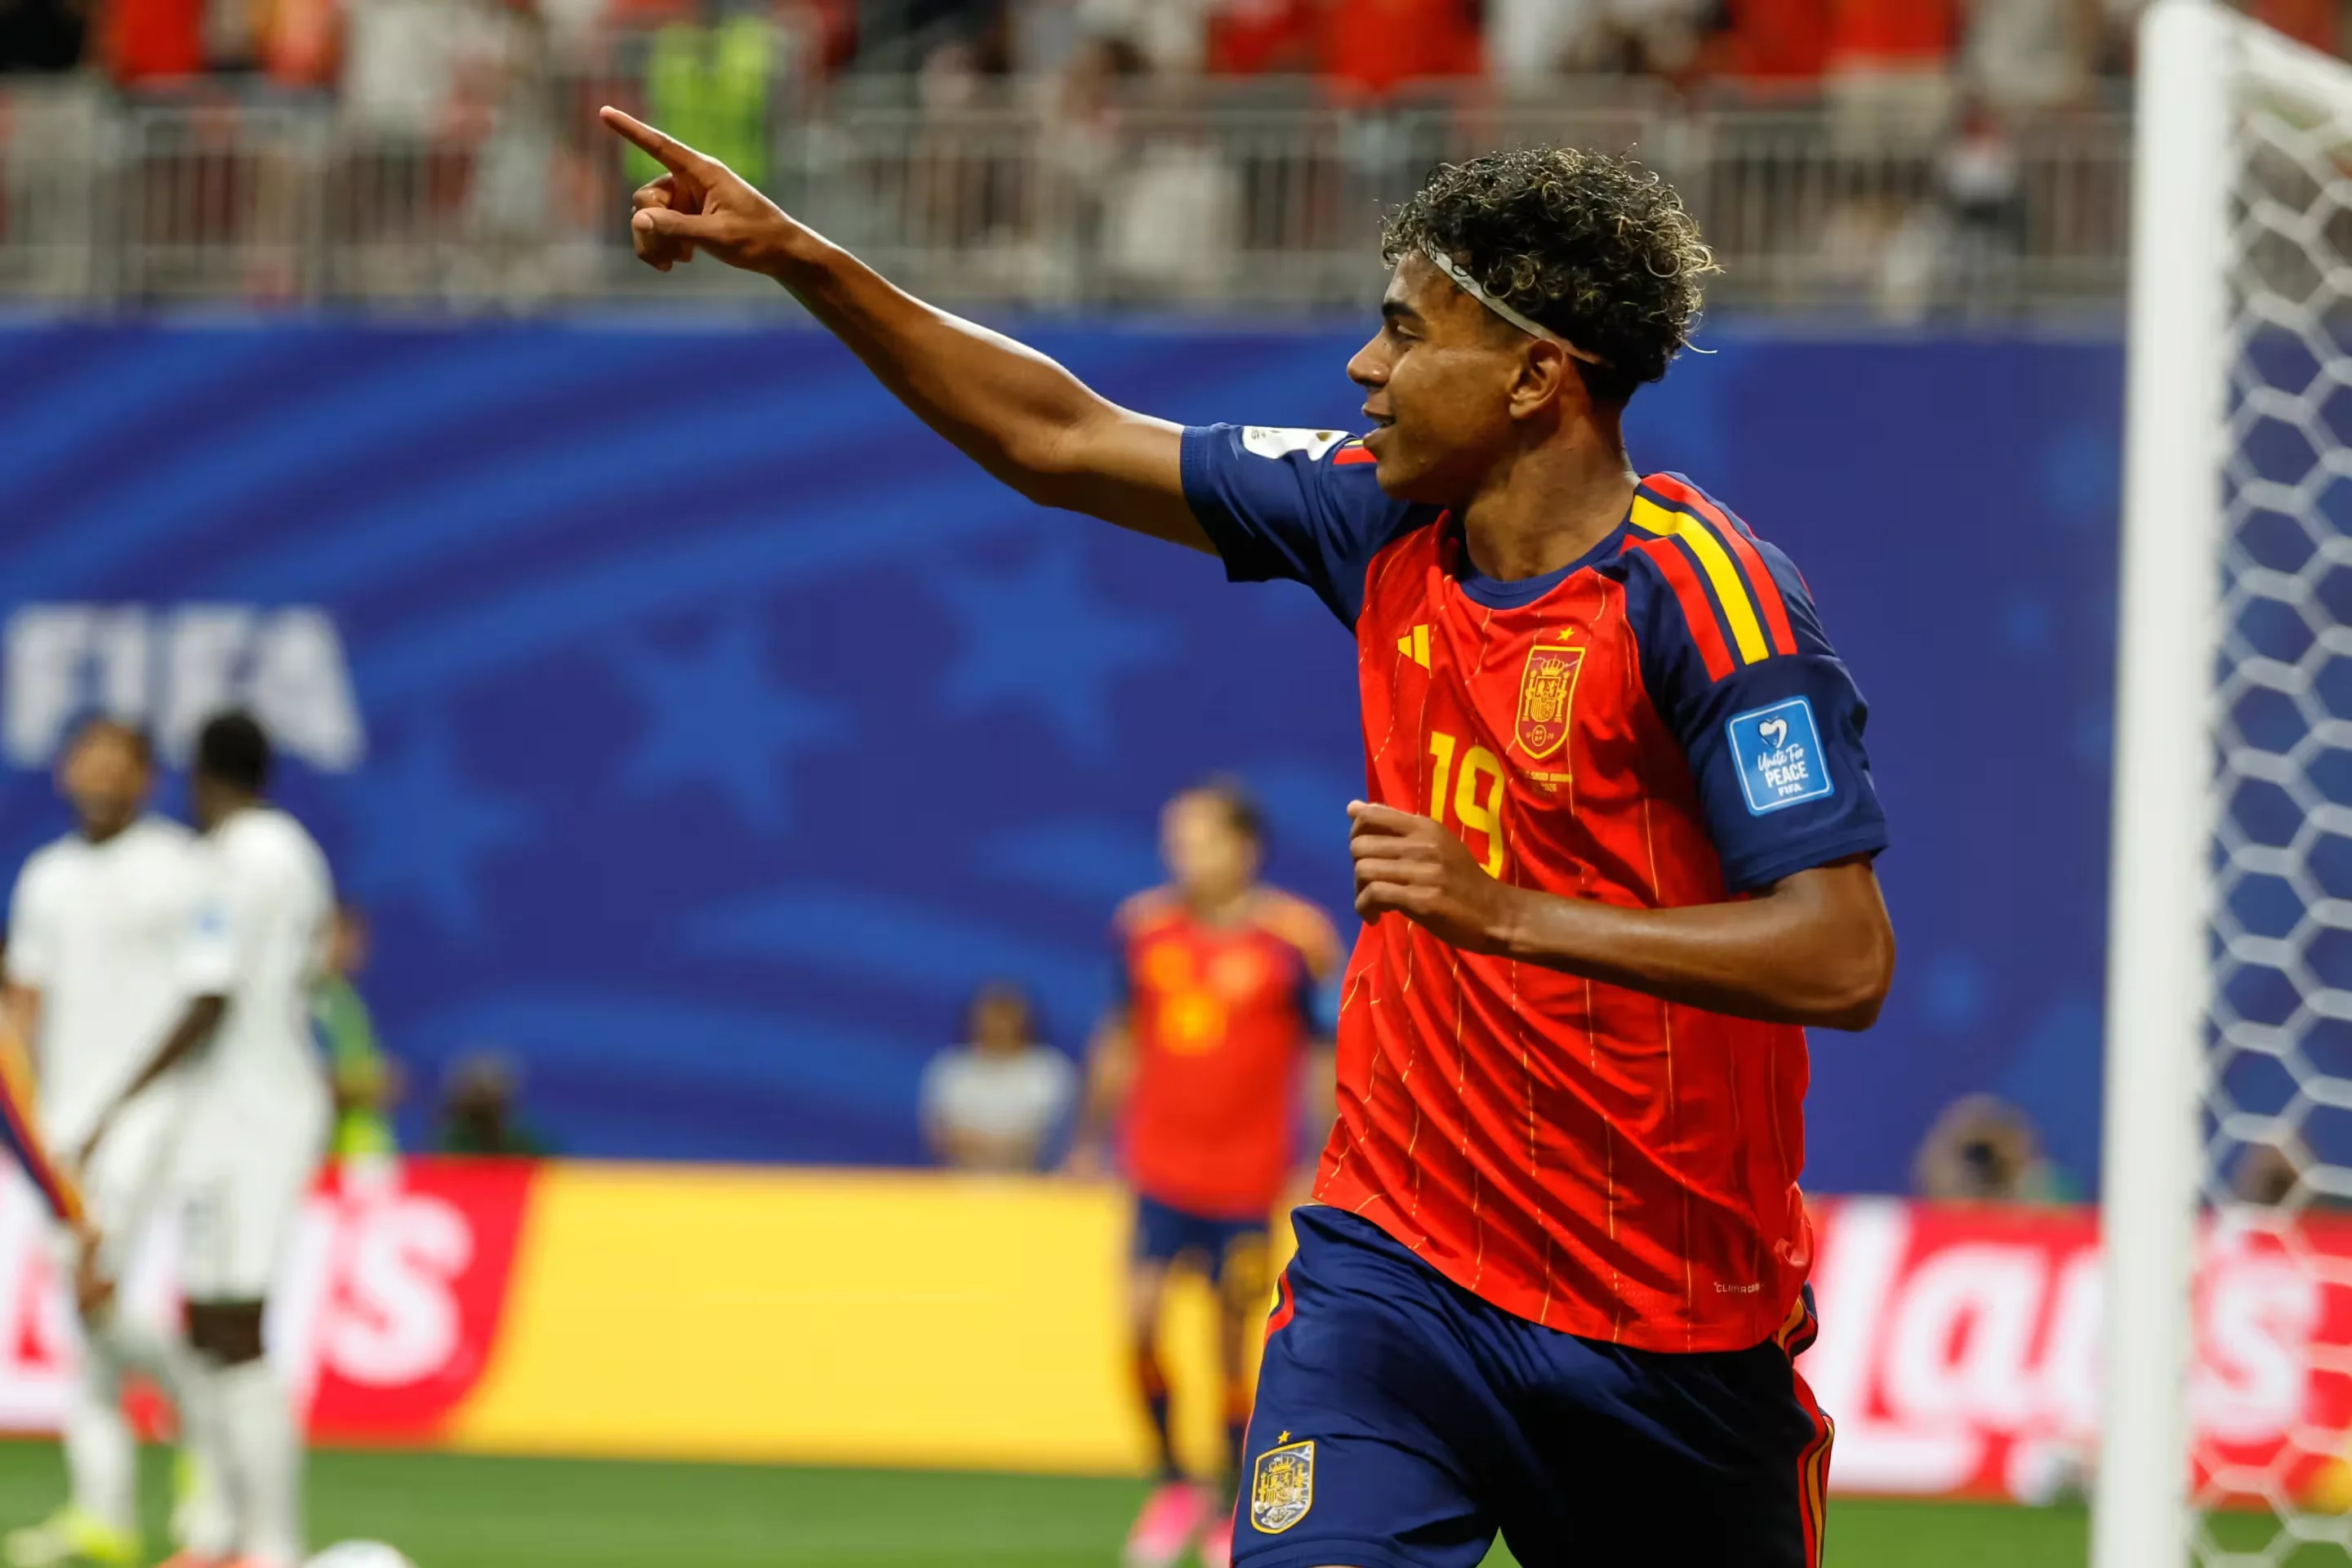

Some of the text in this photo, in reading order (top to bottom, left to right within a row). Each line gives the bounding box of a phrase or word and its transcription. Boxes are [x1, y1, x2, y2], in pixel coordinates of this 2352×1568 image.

[7, 603, 364, 773] FIFA
[1757, 751, 1788, 772] Unite
[1765, 761, 1808, 788] PEACE
[1778, 783, 1803, 796] FIFA
[1429, 730, 1505, 880] 19
